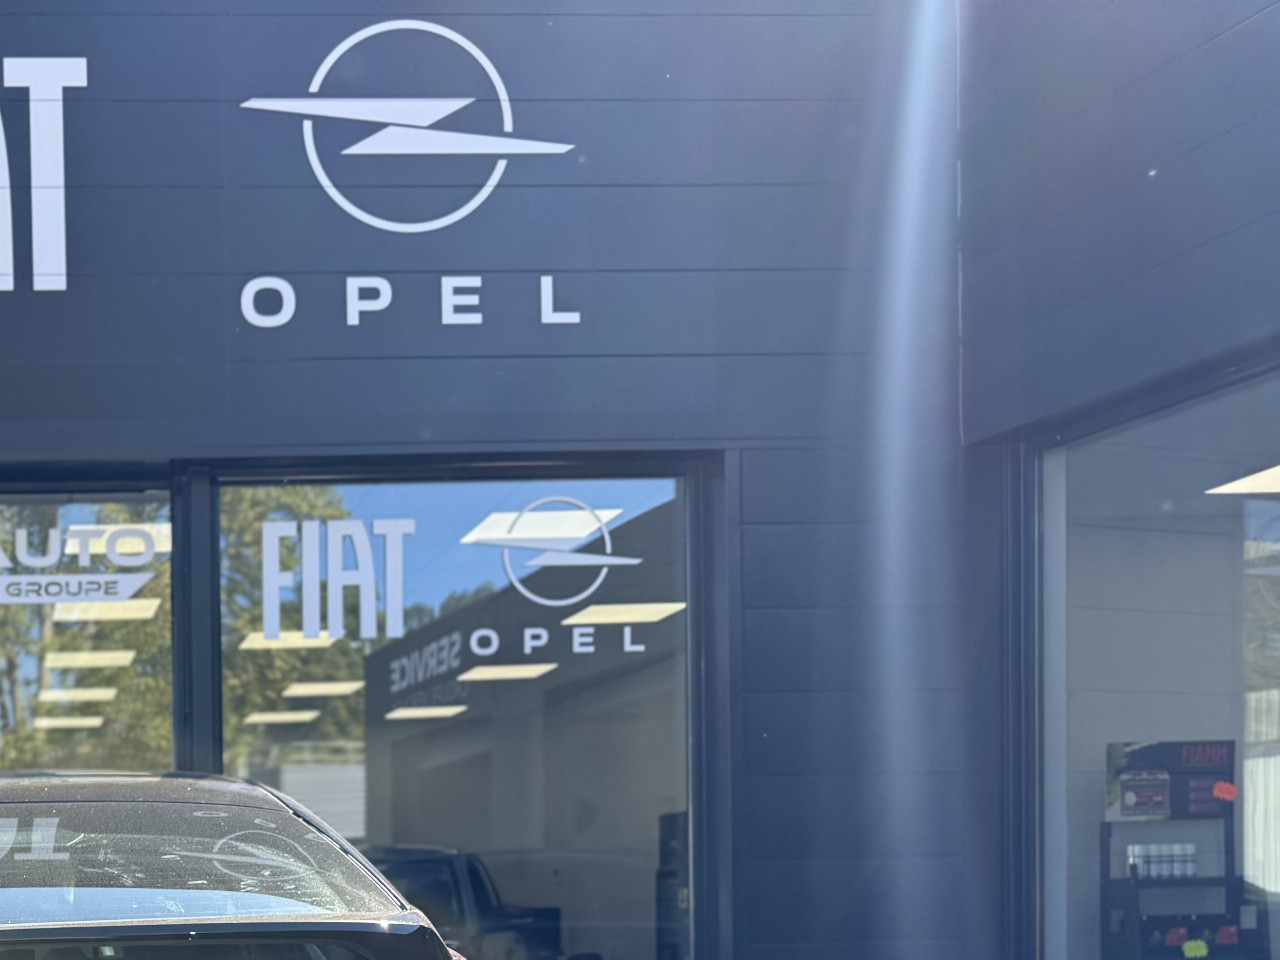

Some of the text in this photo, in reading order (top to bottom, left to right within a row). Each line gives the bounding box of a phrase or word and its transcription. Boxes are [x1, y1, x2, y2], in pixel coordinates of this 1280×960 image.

[239, 274, 582, 328] OPEL
[4, 578, 120, 598] GROUPE
[261, 518, 417, 641] FIAT
[469, 625, 646, 656] OPEL
